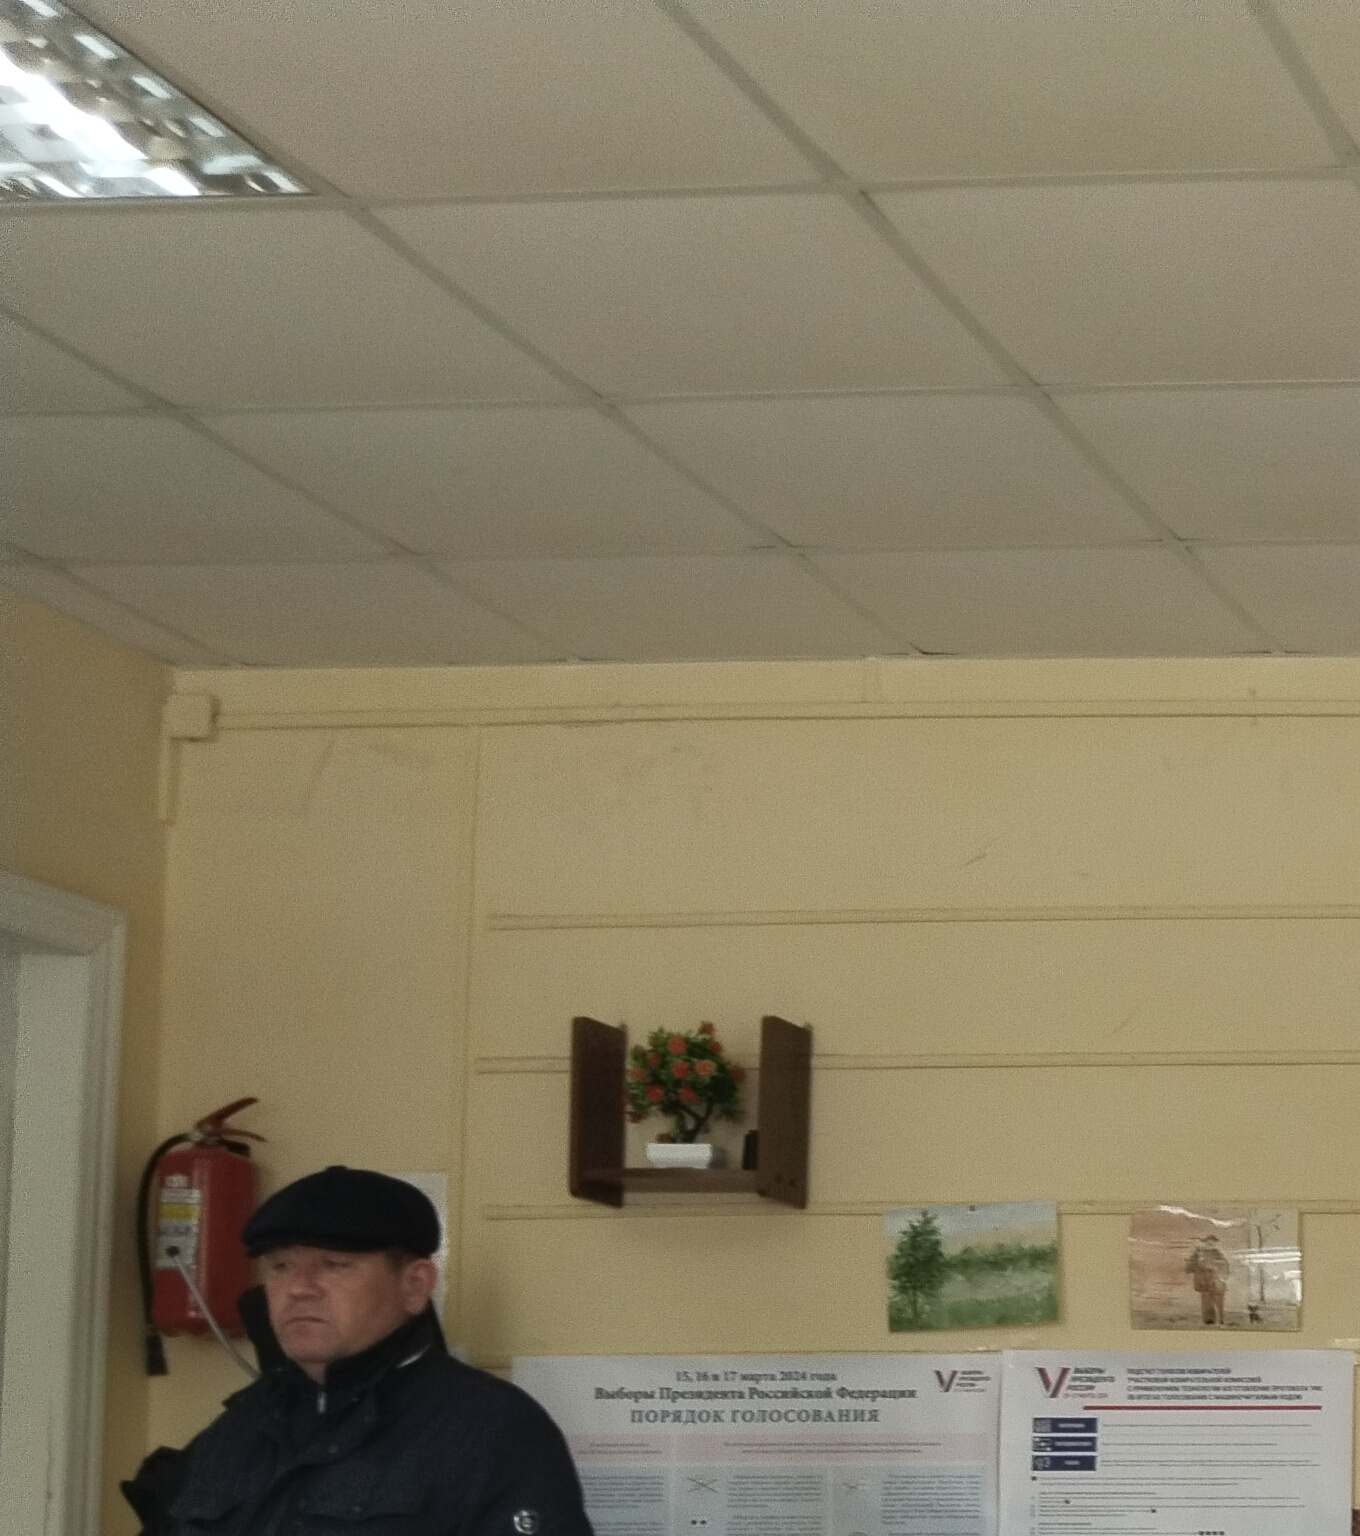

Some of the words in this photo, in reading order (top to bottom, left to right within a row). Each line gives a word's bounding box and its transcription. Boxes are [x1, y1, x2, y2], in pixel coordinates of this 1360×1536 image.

[595, 1387, 655, 1403] Выборы
[659, 1387, 746, 1403] Президента
[748, 1386, 833, 1400] Российской
[836, 1386, 917, 1402] Федерации
[630, 1409, 724, 1424] ПОРЯДОК
[730, 1409, 880, 1423] ГОЛОСОВАНИЯ
